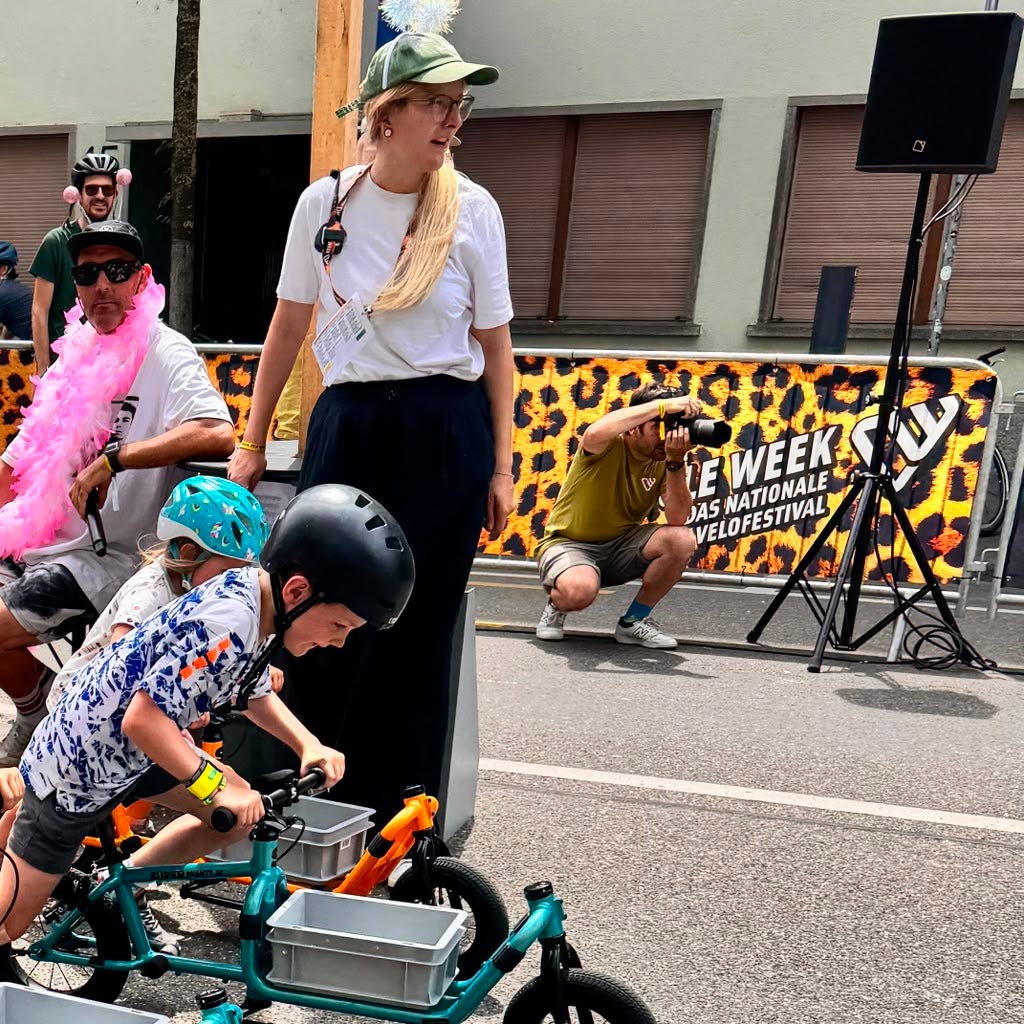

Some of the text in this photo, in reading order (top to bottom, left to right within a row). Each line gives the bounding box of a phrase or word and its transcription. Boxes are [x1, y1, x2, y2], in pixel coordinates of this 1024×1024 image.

[731, 426, 838, 490] WEEK
[725, 470, 829, 515] NATIONALE
[696, 495, 827, 545] VELOFESTIVAL
